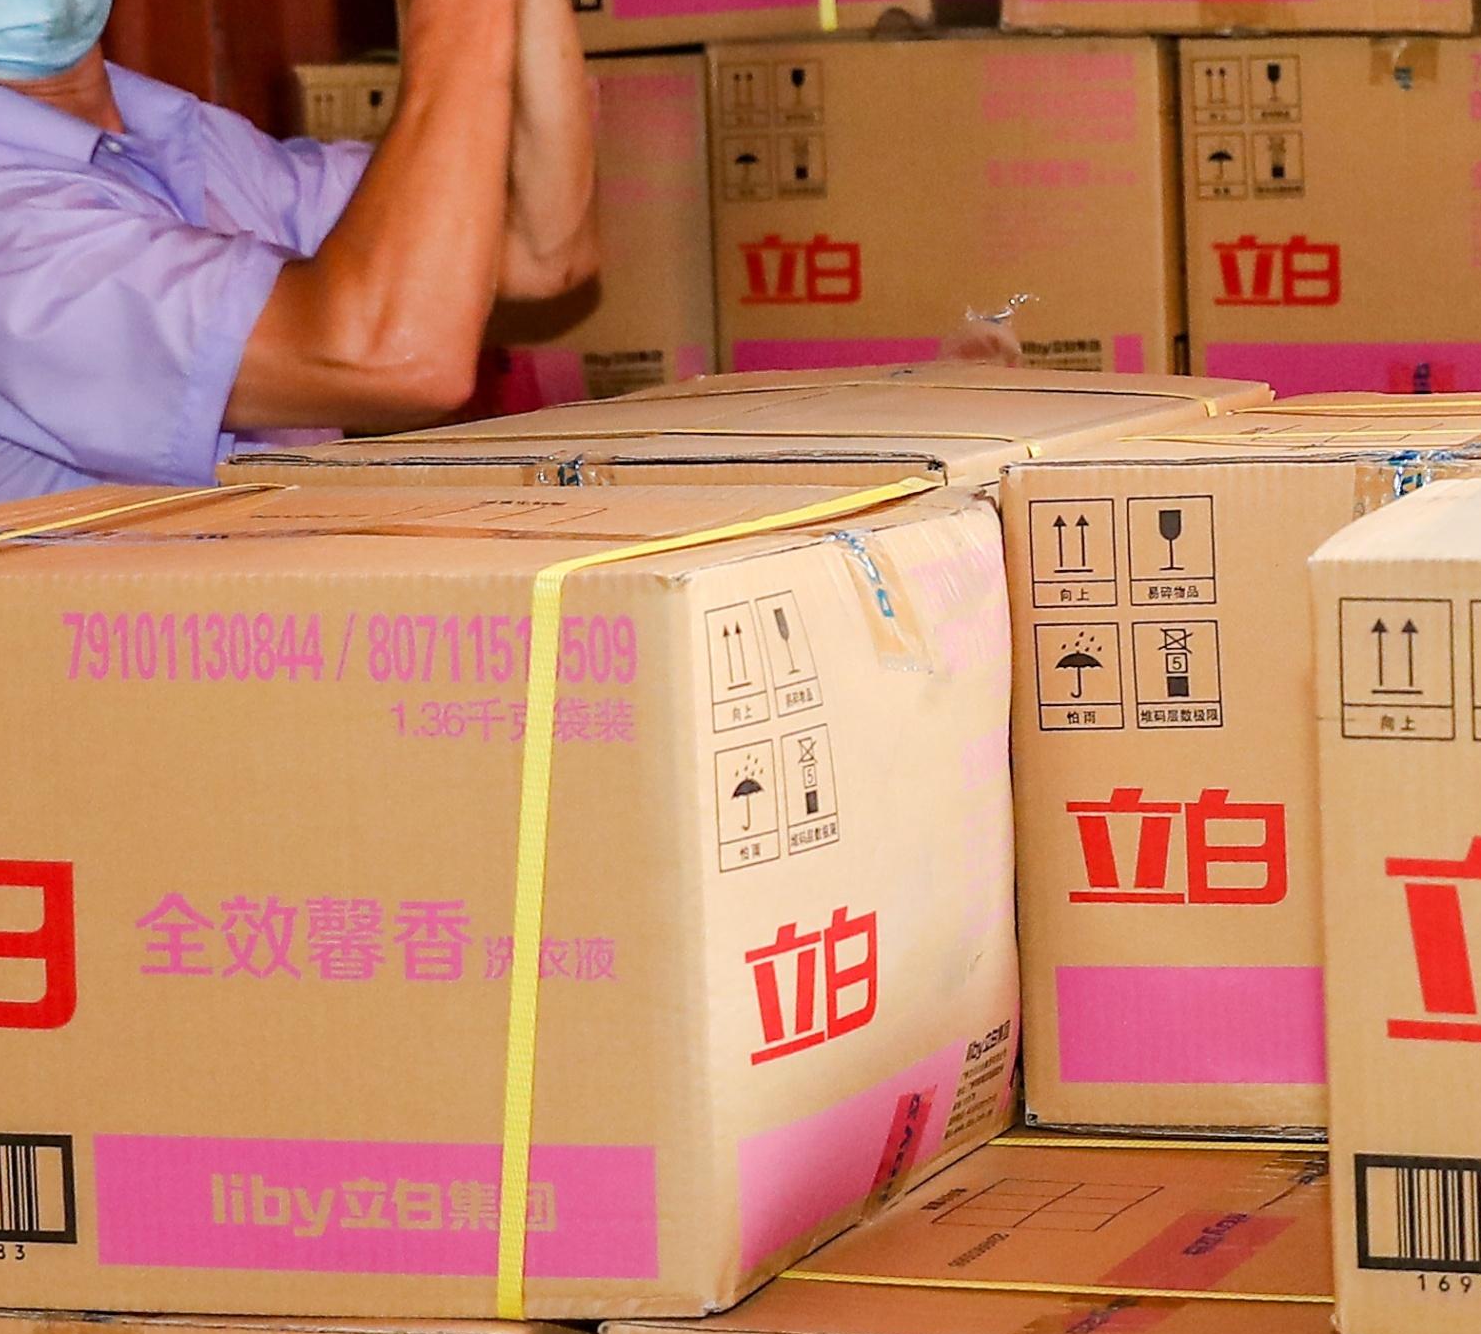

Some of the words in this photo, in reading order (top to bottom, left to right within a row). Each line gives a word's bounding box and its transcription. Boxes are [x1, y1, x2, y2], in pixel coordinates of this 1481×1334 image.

[744, 235, 862, 305] 立白
[1215, 235, 1340, 306] 立白
[1060, 589, 1088, 601] 向上
[1149, 586, 1198, 599] 易碎物品
[63, 613, 324, 680] 79101130844
[335, 611, 358, 681] /
[368, 614, 636, 683] 8071151509
[1171, 656, 1181, 671] 5
[1067, 711, 1095, 724] 怕雨
[1140, 708, 1218, 725] 堆码层数极限
[1381, 716, 1415, 731] 向上
[1067, 788, 1287, 904] 立白
[136, 893, 472, 981] 全效馨香
[484, 936, 617, 981] 洗衣液
[746, 908, 877, 1064] 立白
[211, 1173, 557, 1239] liby立白集团
